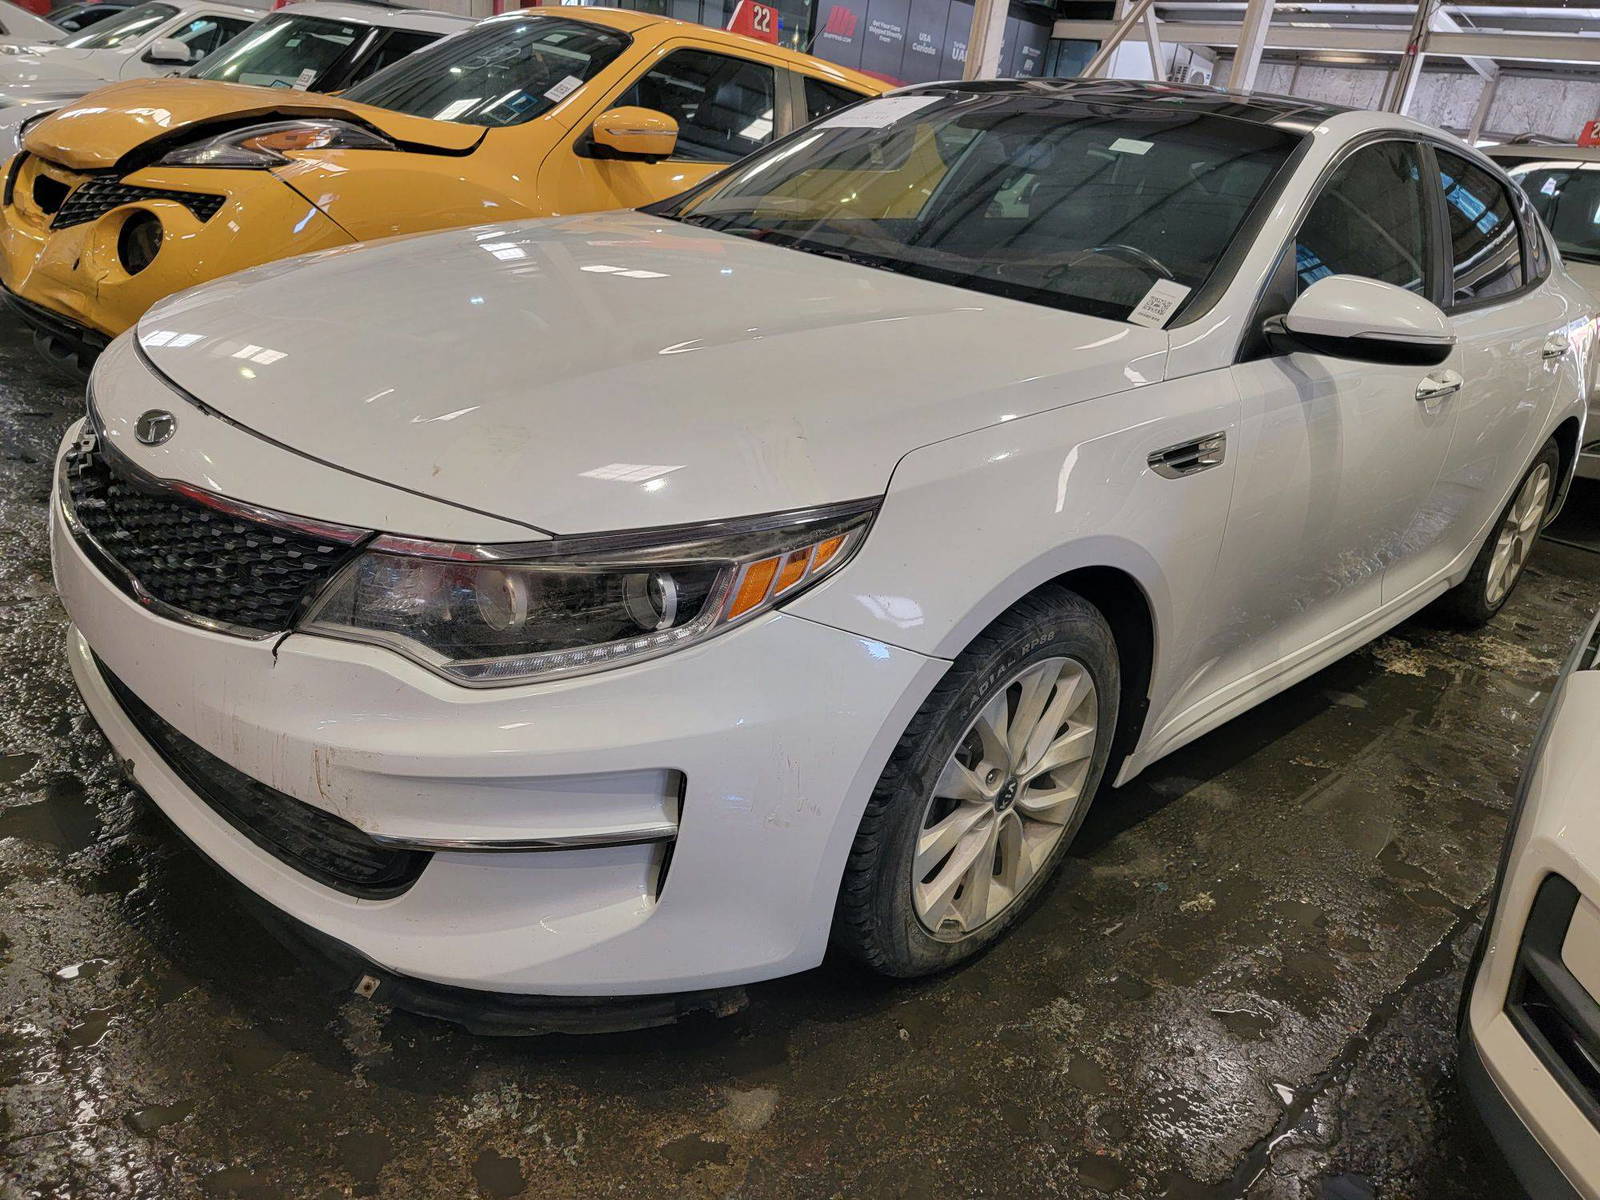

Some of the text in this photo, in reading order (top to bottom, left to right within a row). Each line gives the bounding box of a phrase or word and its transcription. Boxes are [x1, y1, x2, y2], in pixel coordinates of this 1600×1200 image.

[753, 5, 770, 33] 22
[919, 32, 931, 43] USA
[1022, 631, 1056, 656] RP88
